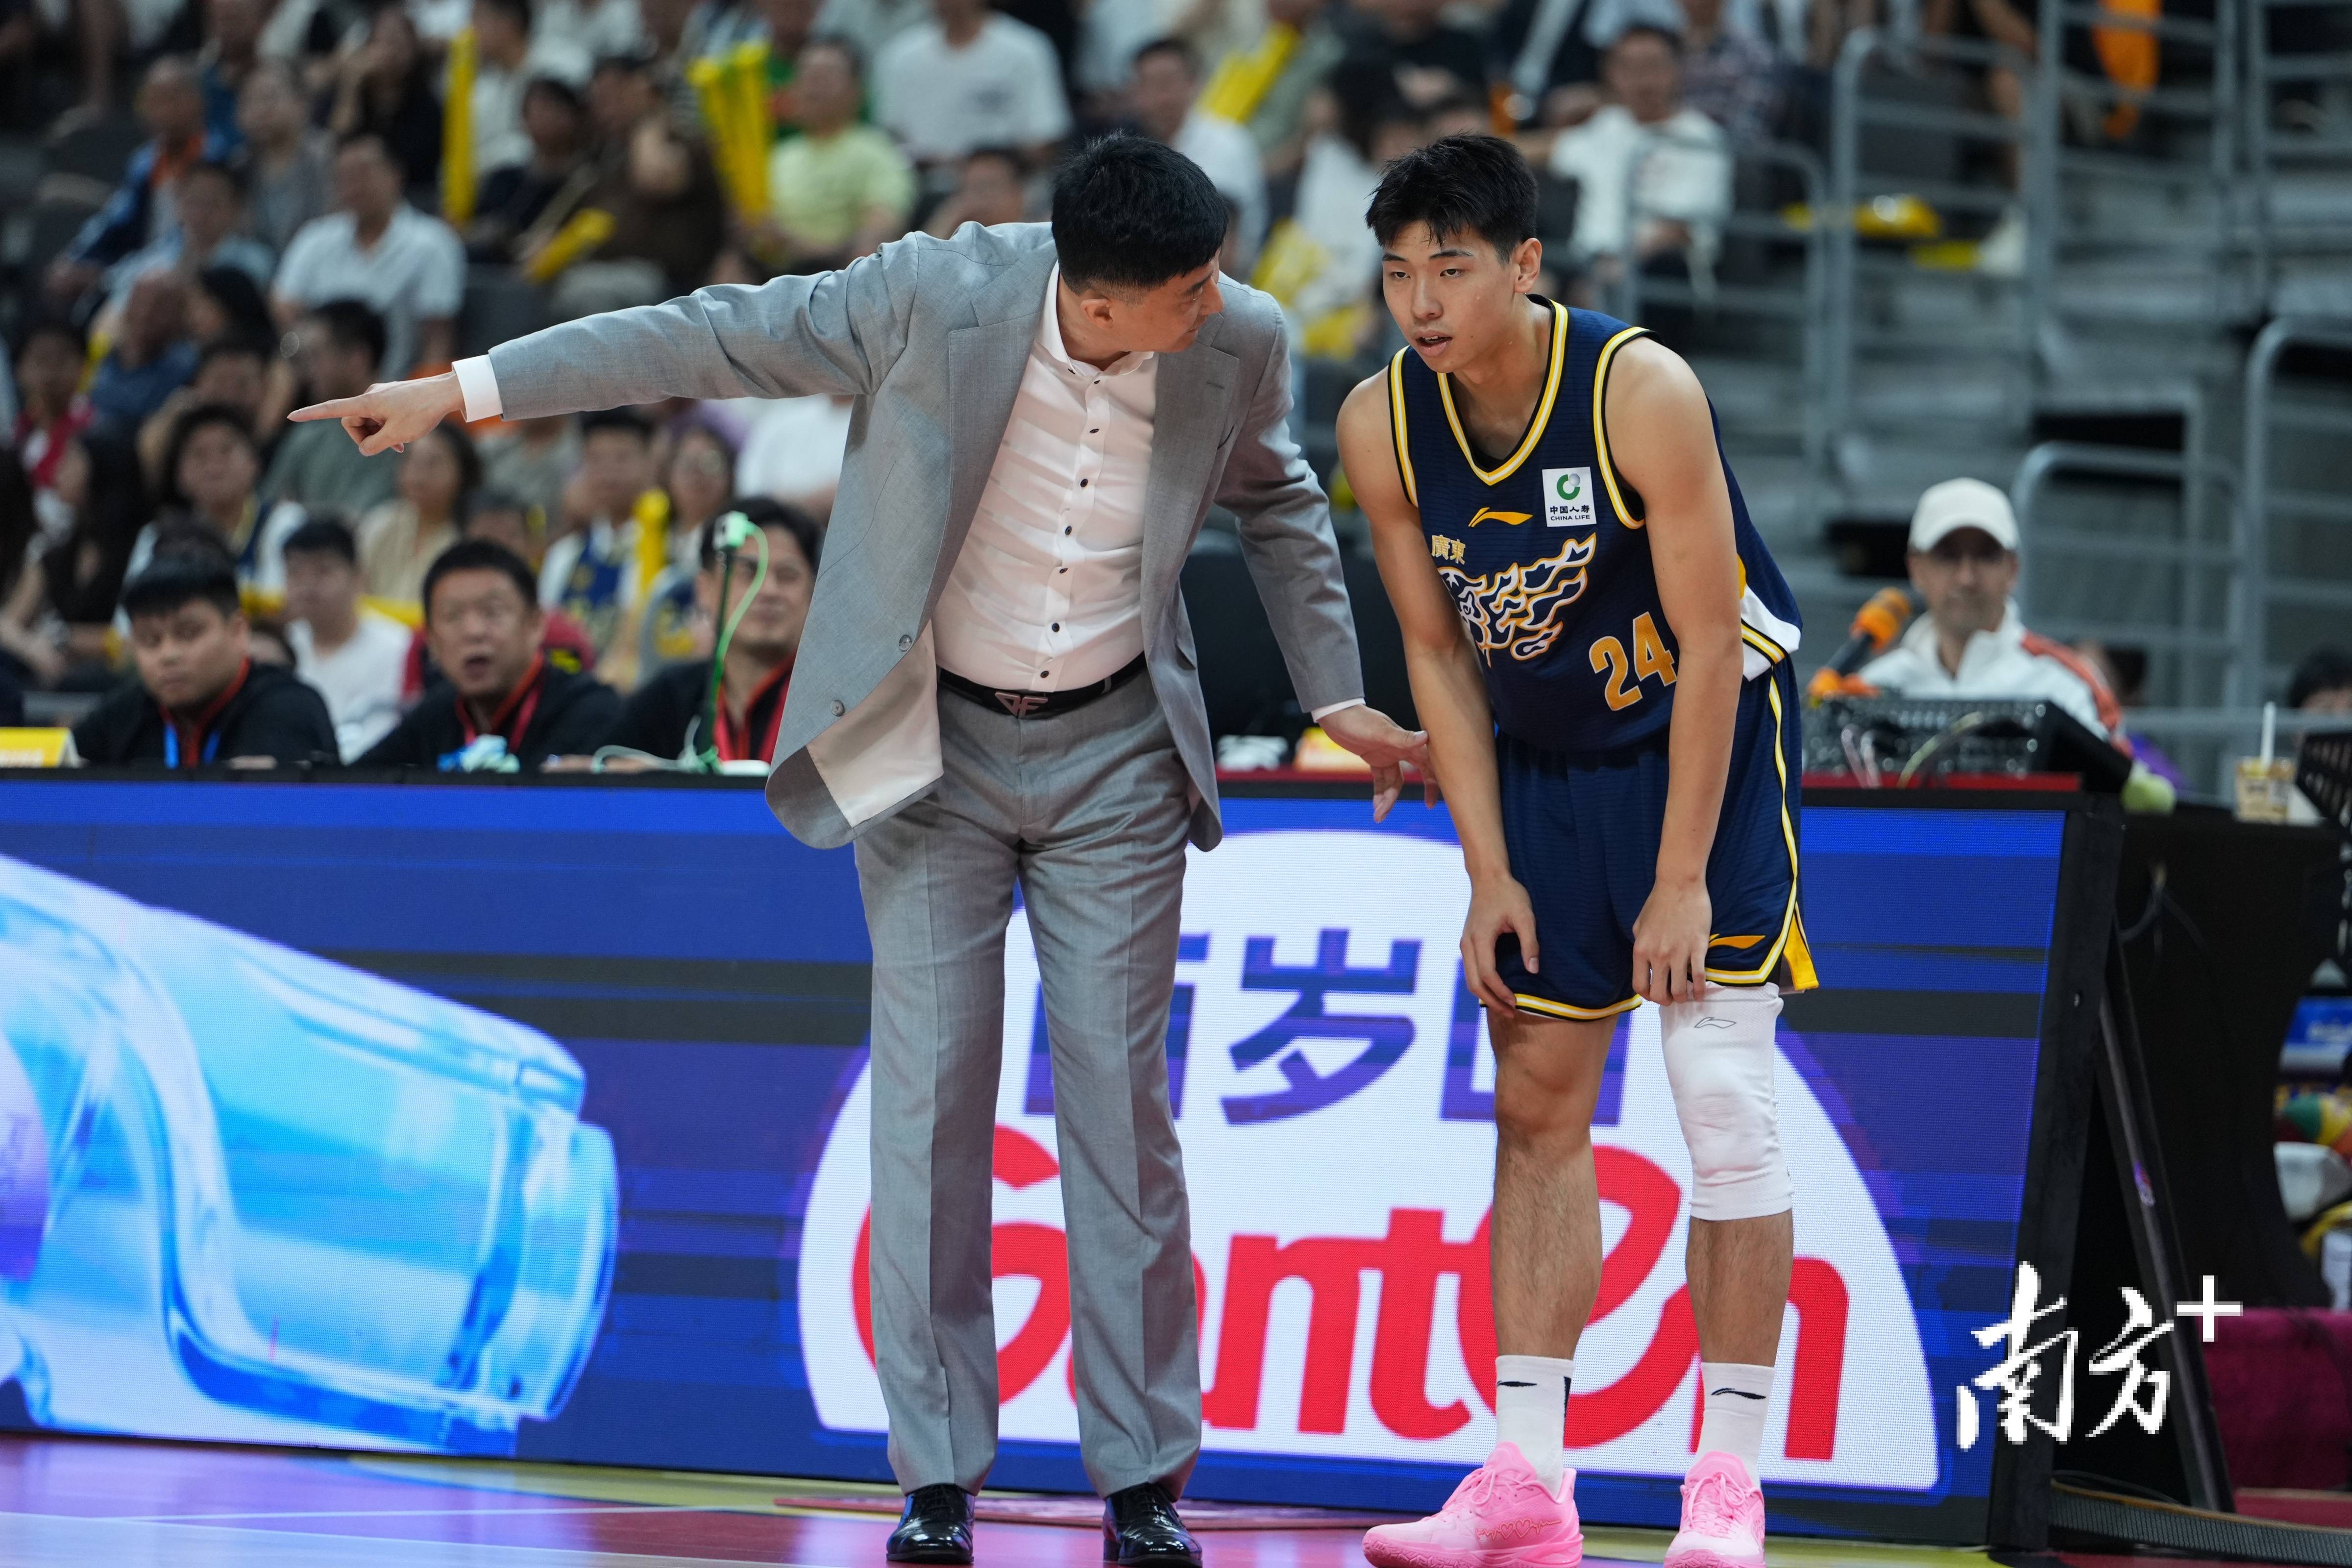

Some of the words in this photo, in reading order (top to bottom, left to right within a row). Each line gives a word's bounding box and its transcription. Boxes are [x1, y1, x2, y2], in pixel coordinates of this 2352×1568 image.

[1550, 505, 1590, 514] 中国人寿
[1589, 611, 1677, 711] 24
